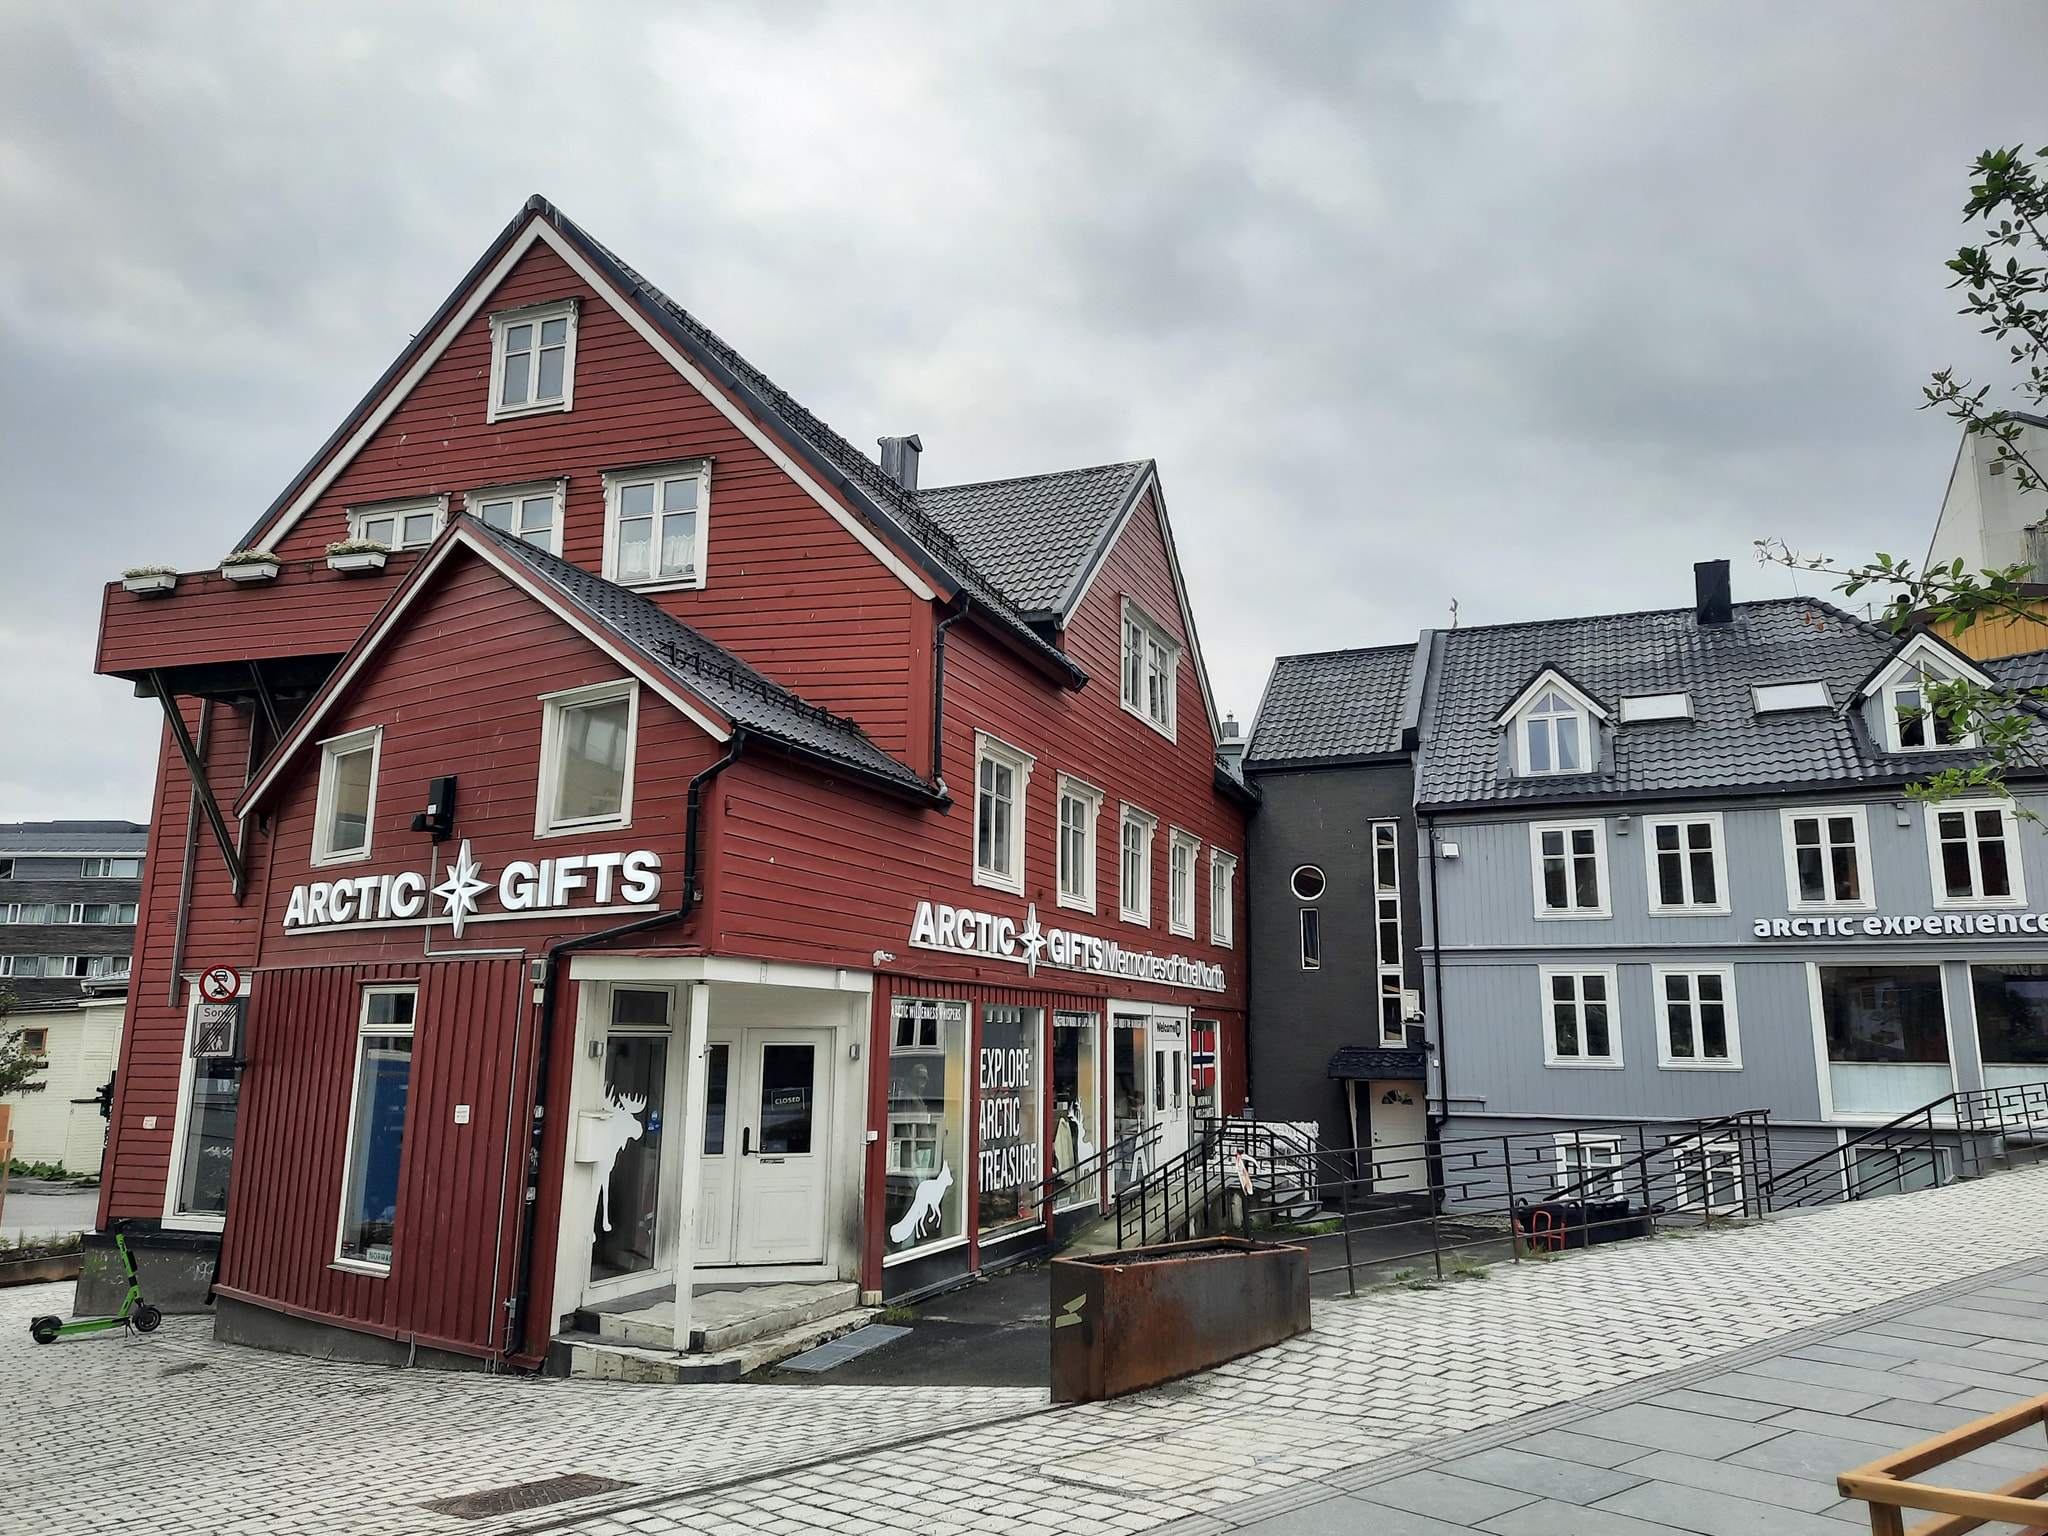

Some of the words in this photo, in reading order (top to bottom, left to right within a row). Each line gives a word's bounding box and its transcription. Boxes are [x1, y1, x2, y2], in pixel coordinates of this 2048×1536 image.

[282, 871, 426, 927] ARCTIC
[498, 850, 662, 911] GIFTS
[912, 901, 1015, 955] ARCTIC
[1046, 928, 1103, 970] GIFTS
[1102, 939, 1166, 980] Memories
[204, 1007, 226, 1018] Son
[909, 1005, 938, 1020] WILDERNESS
[979, 1047, 1030, 1089] EXPLORE
[774, 1096, 801, 1105] CLOSED
[978, 1096, 1020, 1141] ARCTIC
[978, 1142, 1037, 1194] TREASURE
